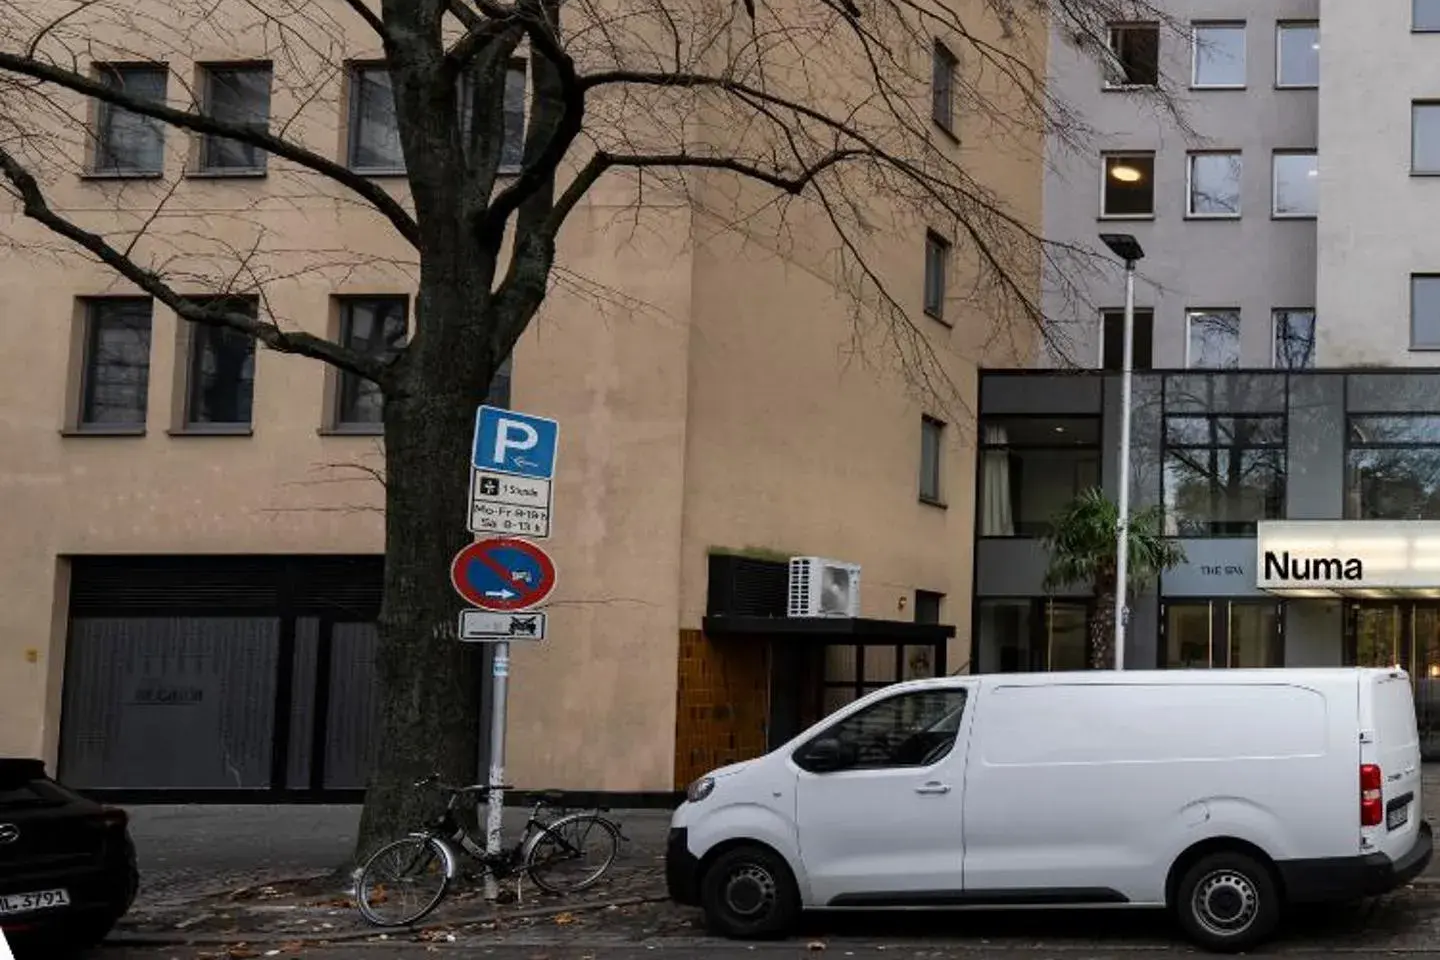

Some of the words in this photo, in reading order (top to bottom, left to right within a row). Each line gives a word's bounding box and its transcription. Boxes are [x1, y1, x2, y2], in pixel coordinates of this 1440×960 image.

[494, 418, 538, 463] P
[1200, 565, 1222, 576] THE
[1264, 551, 1363, 580] Numa
